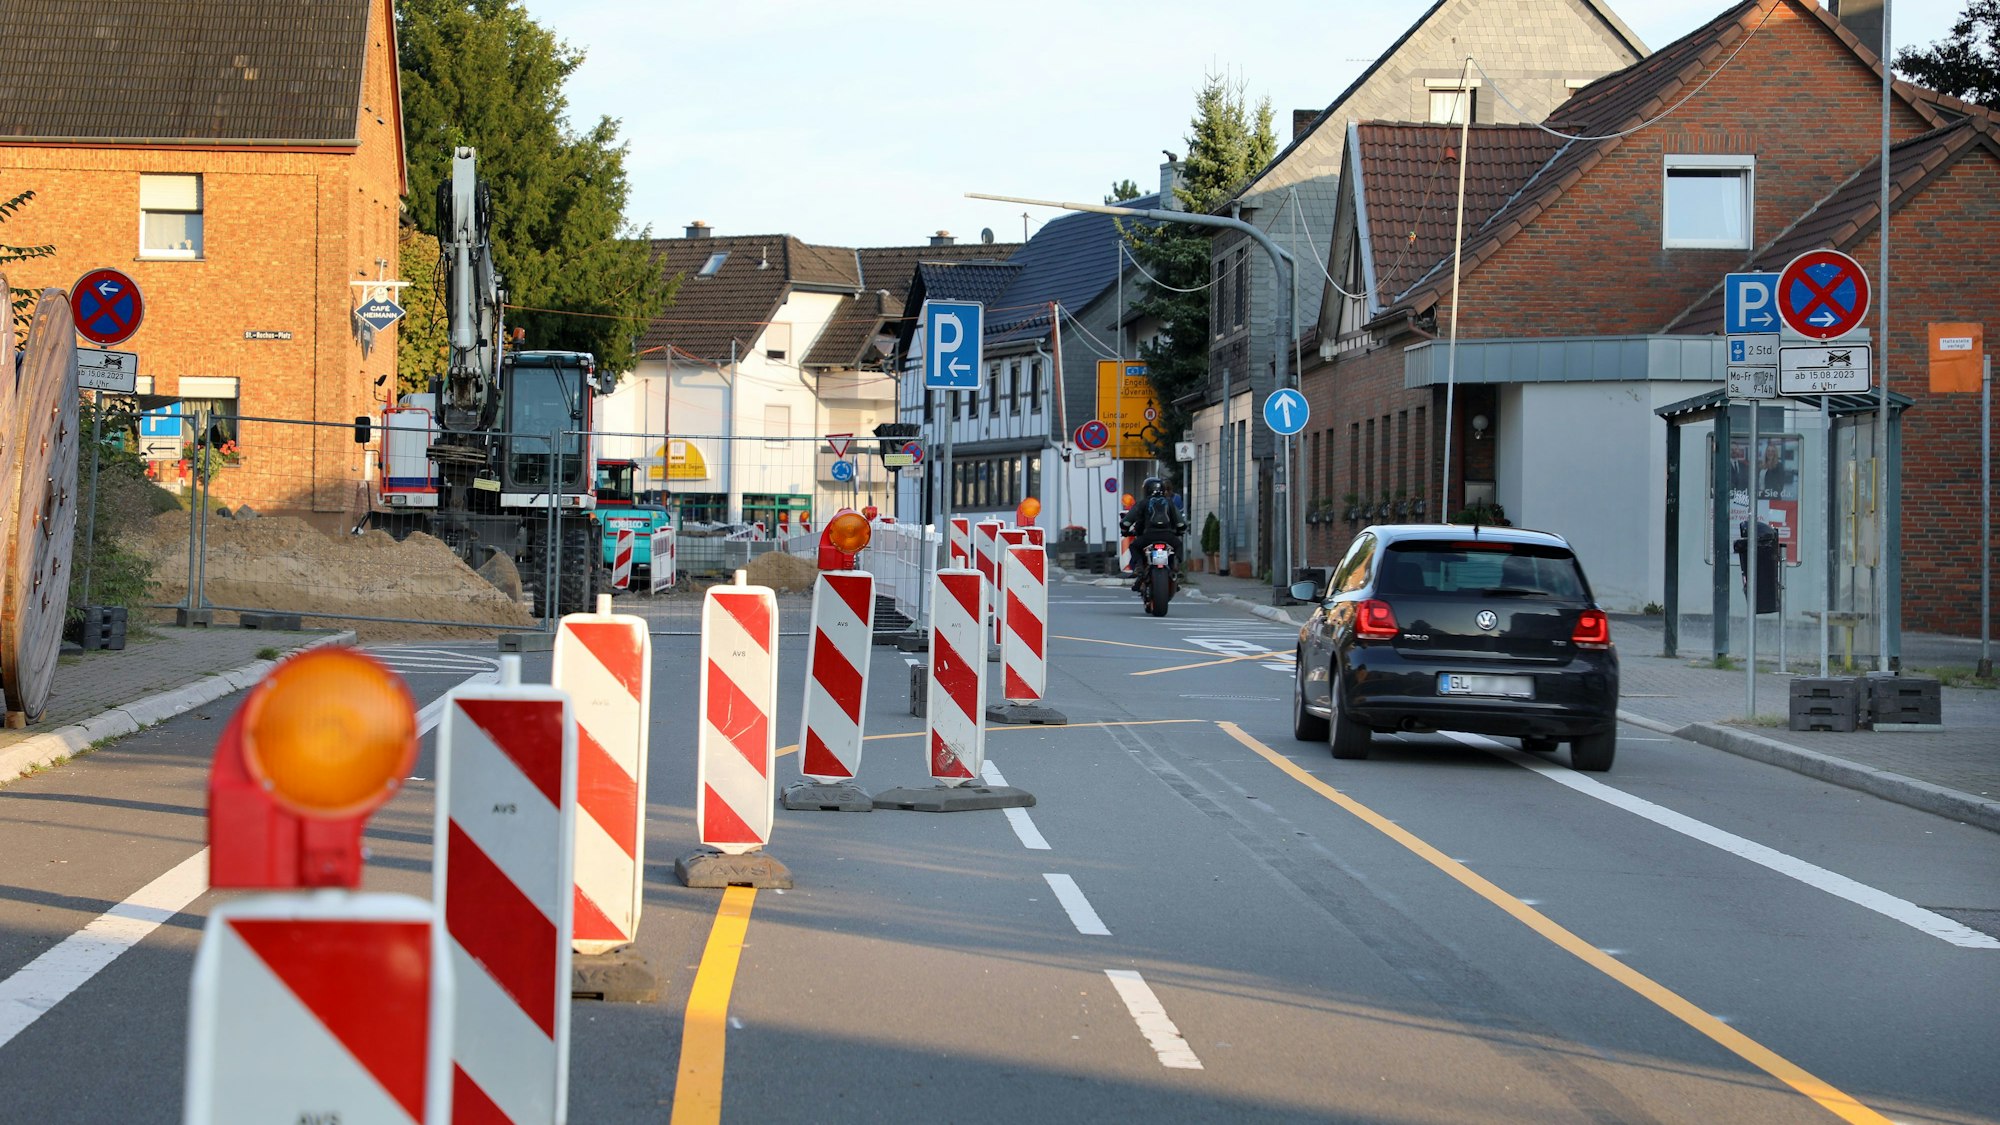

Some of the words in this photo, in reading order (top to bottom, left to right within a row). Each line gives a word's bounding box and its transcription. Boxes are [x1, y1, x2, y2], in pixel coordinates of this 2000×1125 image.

[370, 304, 391, 312] CAFÉ
[1738, 281, 1769, 327] P
[934, 313, 964, 377] P
[1748, 345, 1754, 356] 2
[1756, 345, 1776, 355] Std.
[88, 370, 124, 381] 15.08.2023
[1730, 371, 1752, 381] Mo-Fr
[1794, 371, 1806, 380] ab
[1809, 370, 1855, 380] 15.08.2023
[1730, 383, 1739, 393] Sa
[1811, 382, 1817, 390] 6
[1820, 382, 1838, 390] Uhr
[150, 403, 173, 432] P
[1764, 488, 1779, 497] Sie
[610, 520, 643, 528] KOBELCO
[1450, 676, 1470, 690] GL
[491, 803, 517, 816] AVS
[710, 864, 766, 876] AVS
